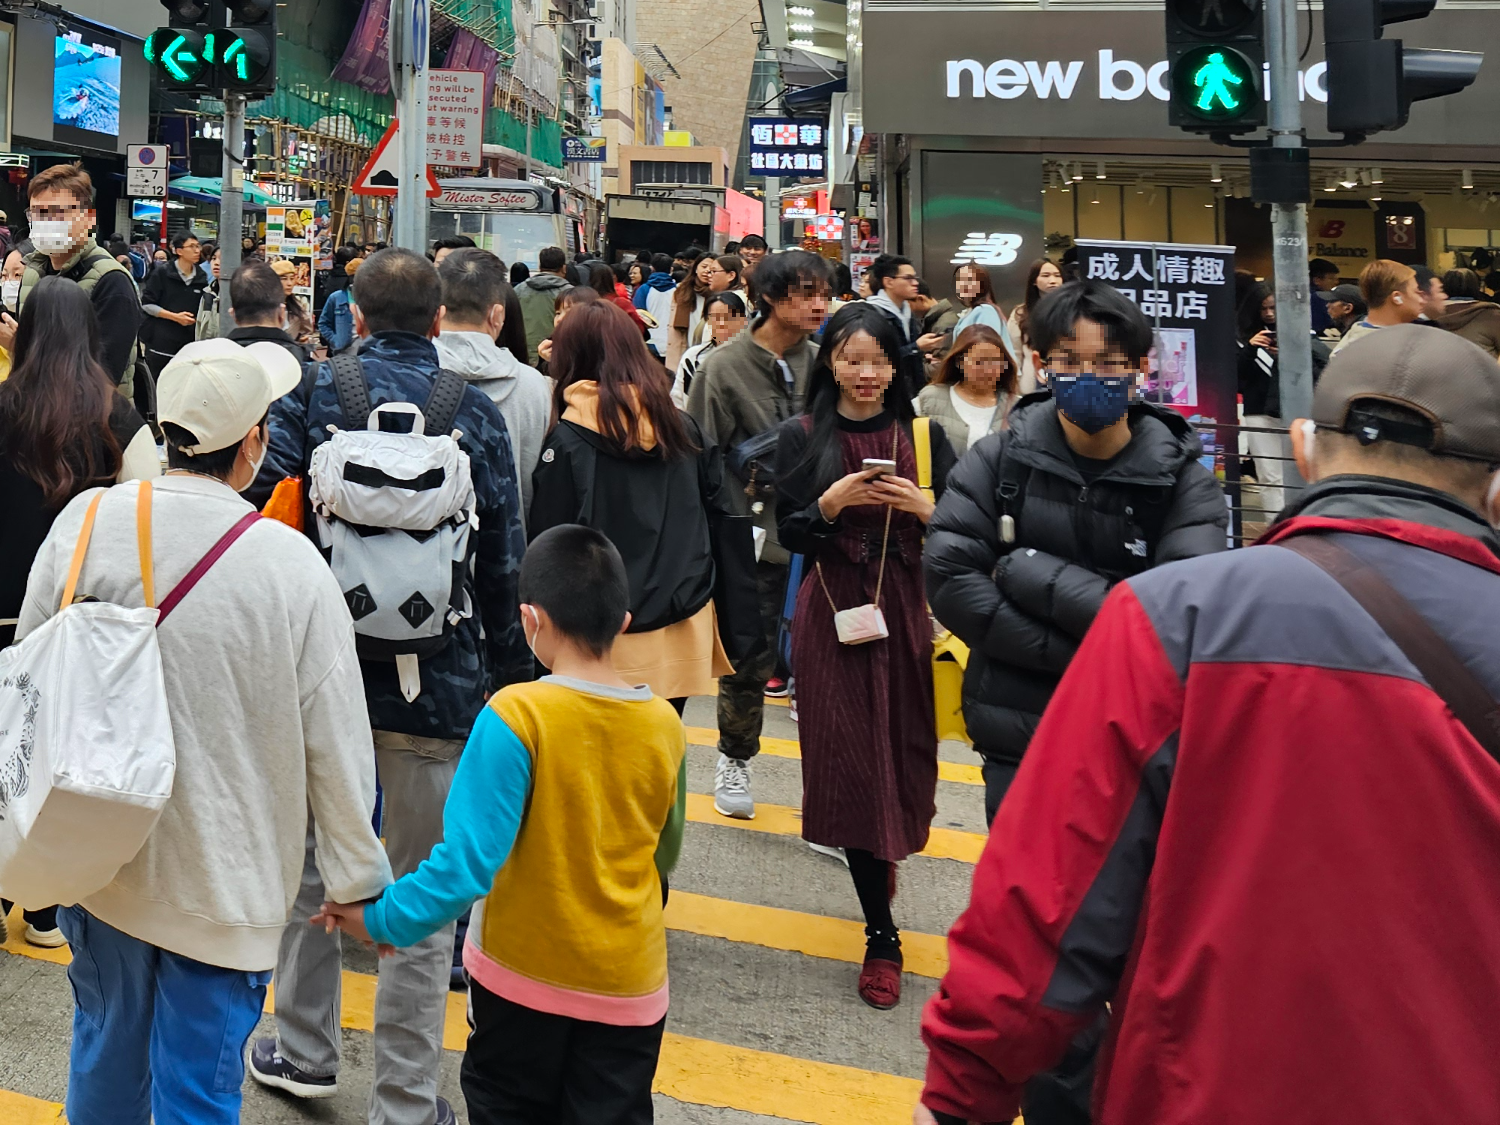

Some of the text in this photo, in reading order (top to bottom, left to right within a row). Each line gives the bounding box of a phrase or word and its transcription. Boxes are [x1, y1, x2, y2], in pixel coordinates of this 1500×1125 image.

[946, 59, 1084, 100] new
[444, 84, 461, 92] will
[463, 85, 475, 93] be
[440, 105, 479, 114] warning
[151, 170, 158, 179] 7
[152, 186, 164, 195] 12
[443, 191, 527, 207] Mister Softee
[1315, 243, 1368, 258] Balance
[1087, 252, 1226, 286] 成人情趣
